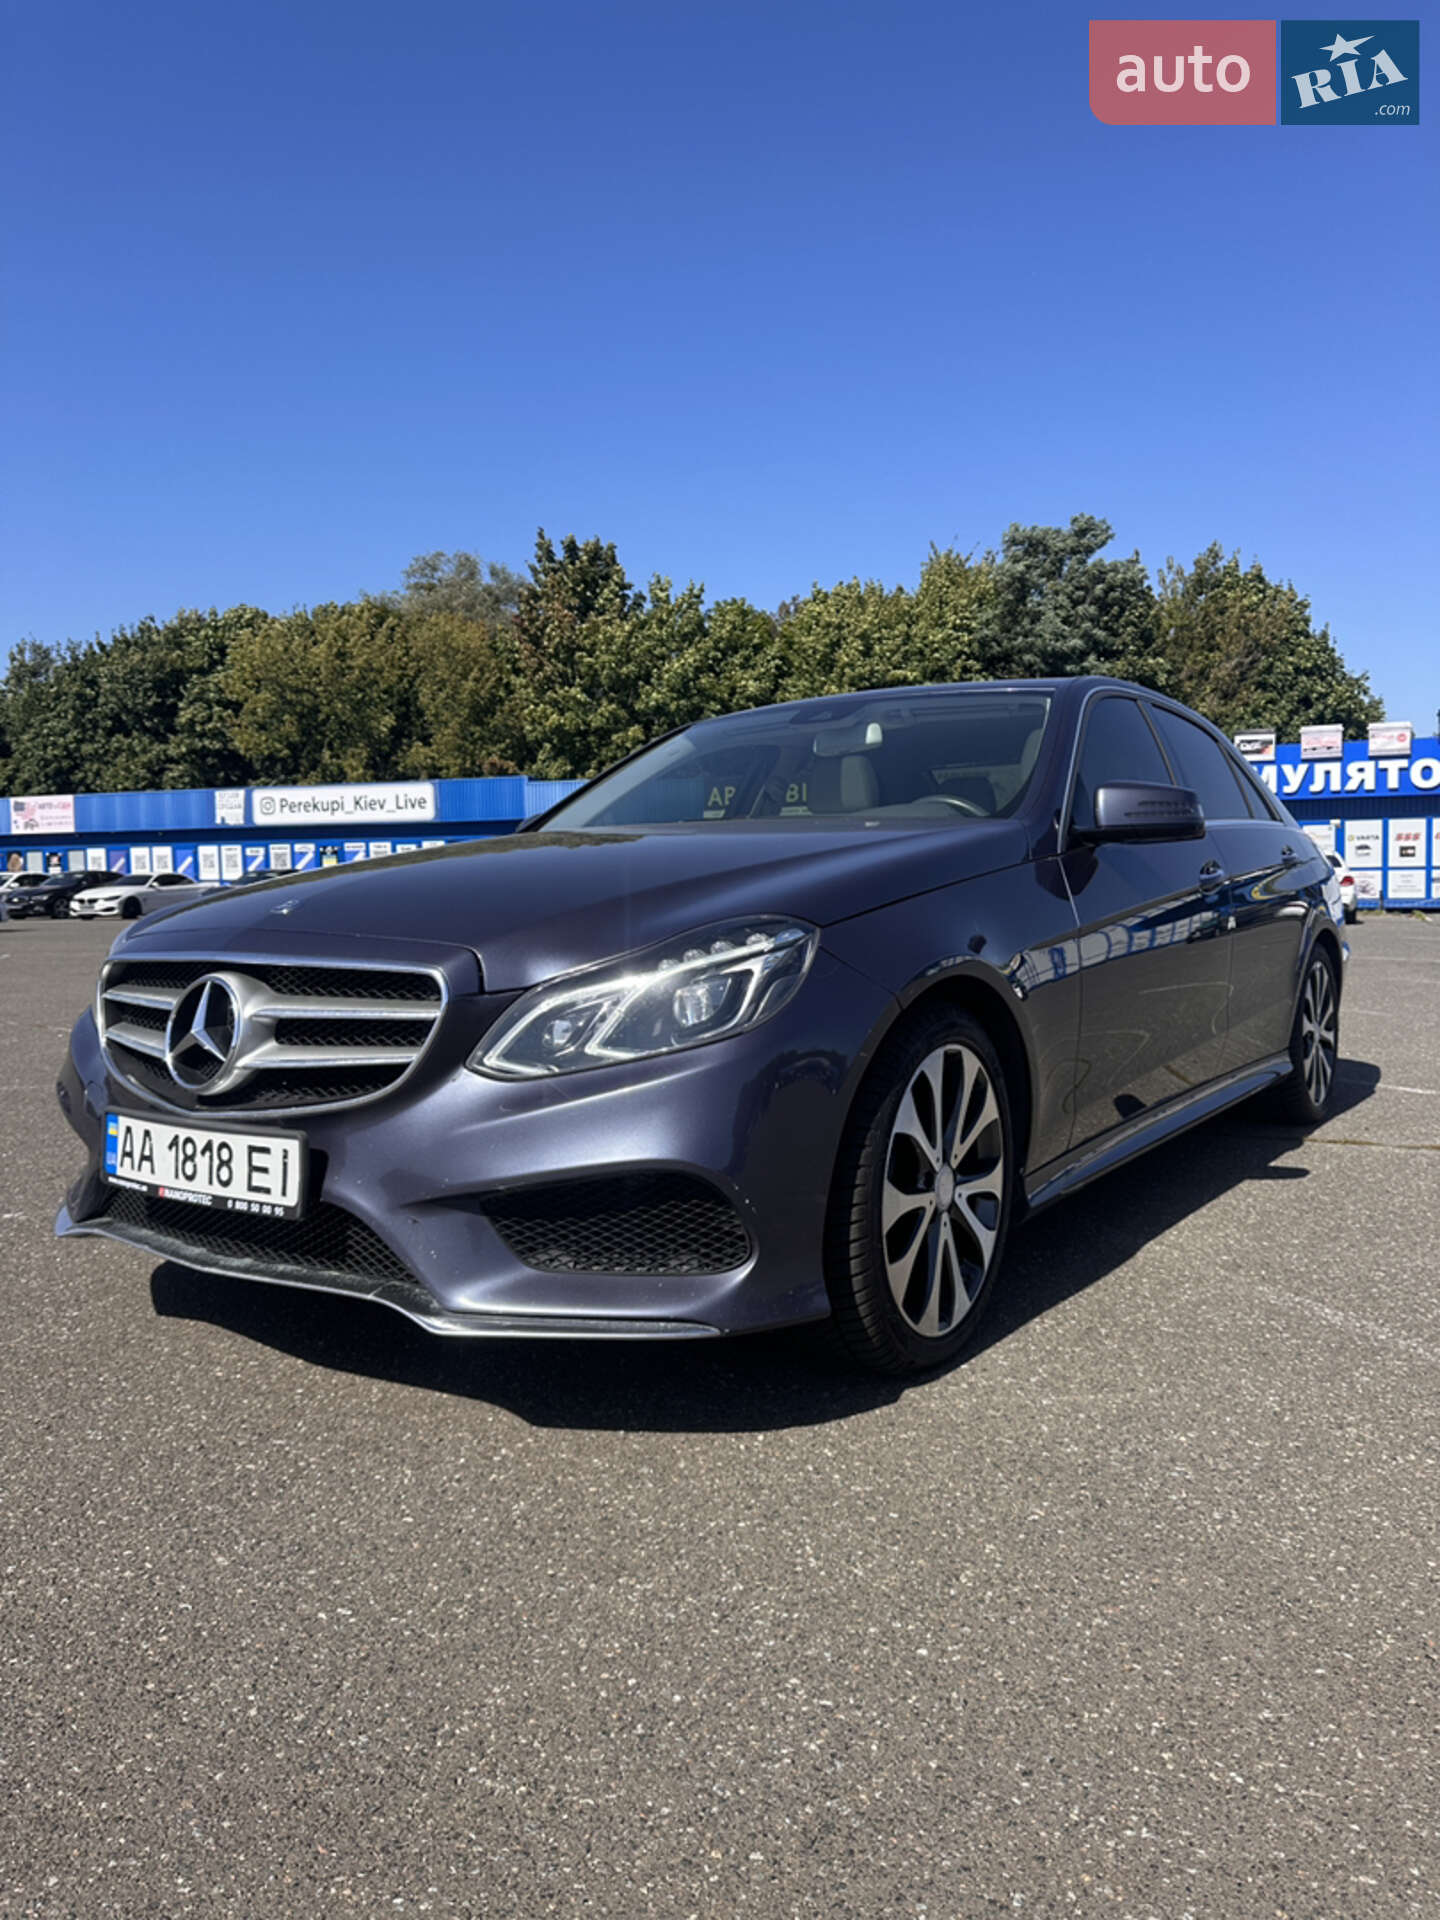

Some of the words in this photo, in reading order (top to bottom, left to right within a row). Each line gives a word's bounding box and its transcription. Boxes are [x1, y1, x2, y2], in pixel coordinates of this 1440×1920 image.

[279, 793, 428, 816] Perekupi_Kiev_Live
[120, 1125, 155, 1176] AA
[168, 1134, 233, 1188] 1818
